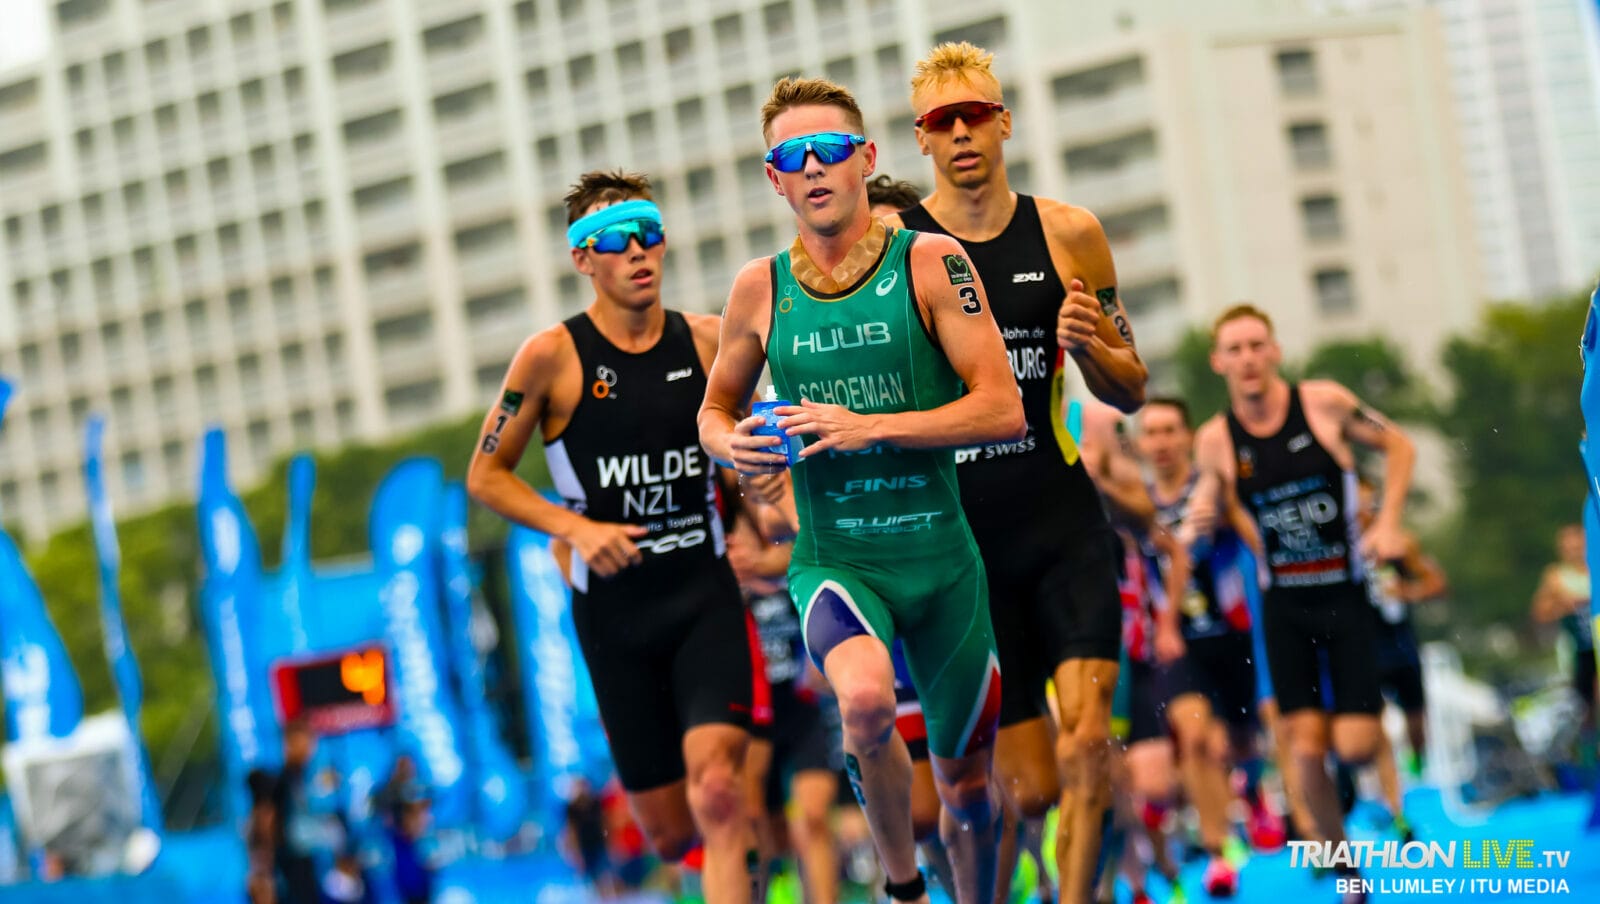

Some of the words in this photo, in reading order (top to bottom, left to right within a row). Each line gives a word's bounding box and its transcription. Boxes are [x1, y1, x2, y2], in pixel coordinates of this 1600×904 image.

[1012, 272, 1045, 283] 2XU
[958, 286, 983, 316] 3
[792, 321, 892, 356] HUUB
[798, 371, 906, 410] SCHOEMAN
[955, 448, 982, 464] DT
[985, 437, 1036, 459] SWISS
[596, 445, 702, 489] WILDE
[844, 475, 927, 493] FINIS
[622, 484, 681, 519] NZL
[834, 511, 943, 529] SWIFT
